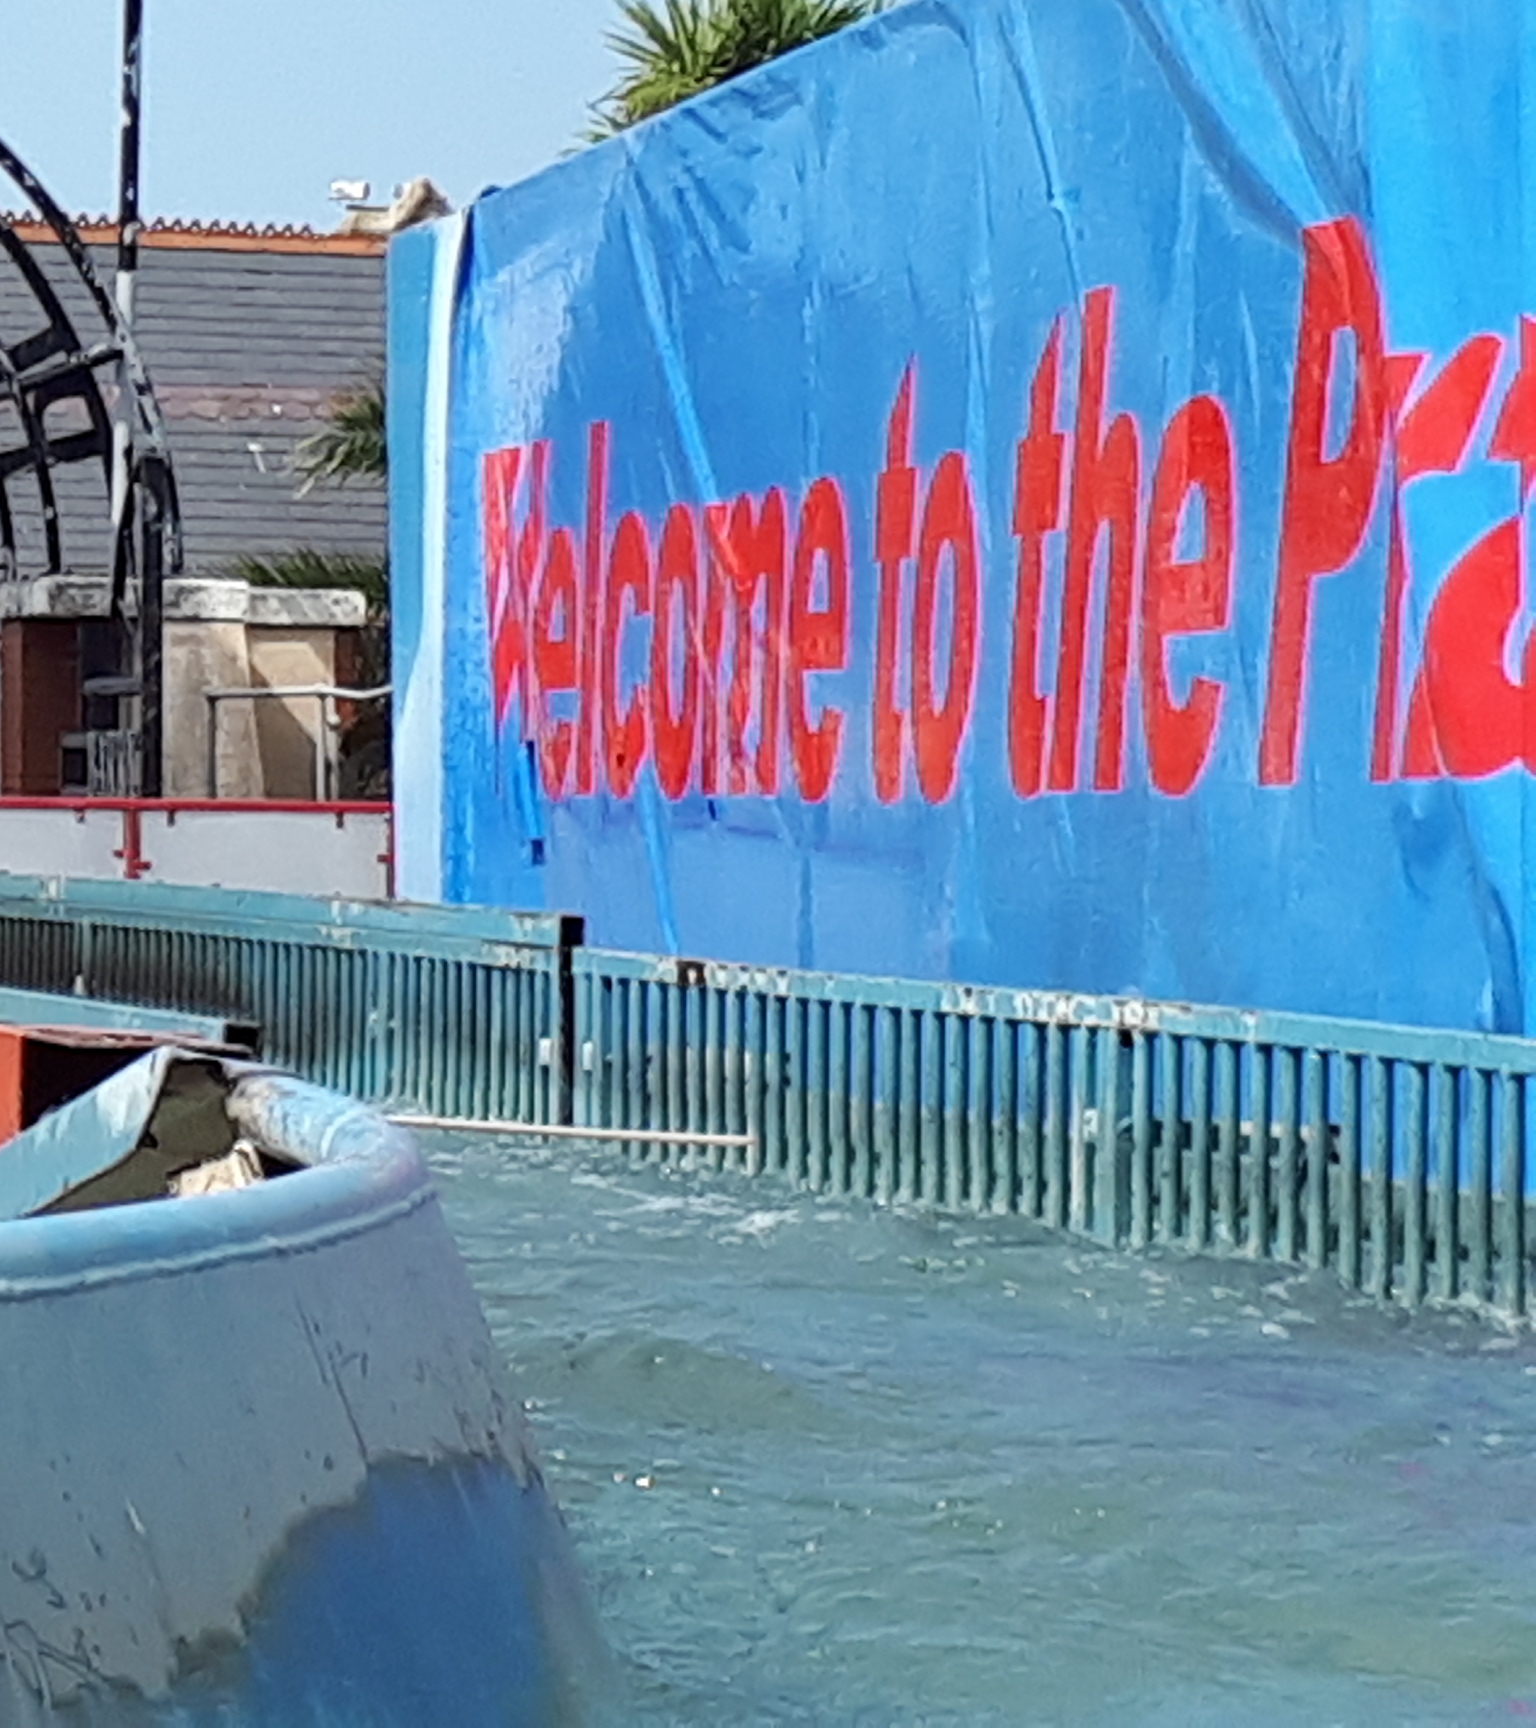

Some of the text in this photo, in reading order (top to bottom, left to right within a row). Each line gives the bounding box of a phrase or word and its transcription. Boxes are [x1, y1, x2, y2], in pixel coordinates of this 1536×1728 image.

[483, 420, 848, 802] Welcome
[873, 354, 980, 805] to
[1008, 284, 1236, 800] the
